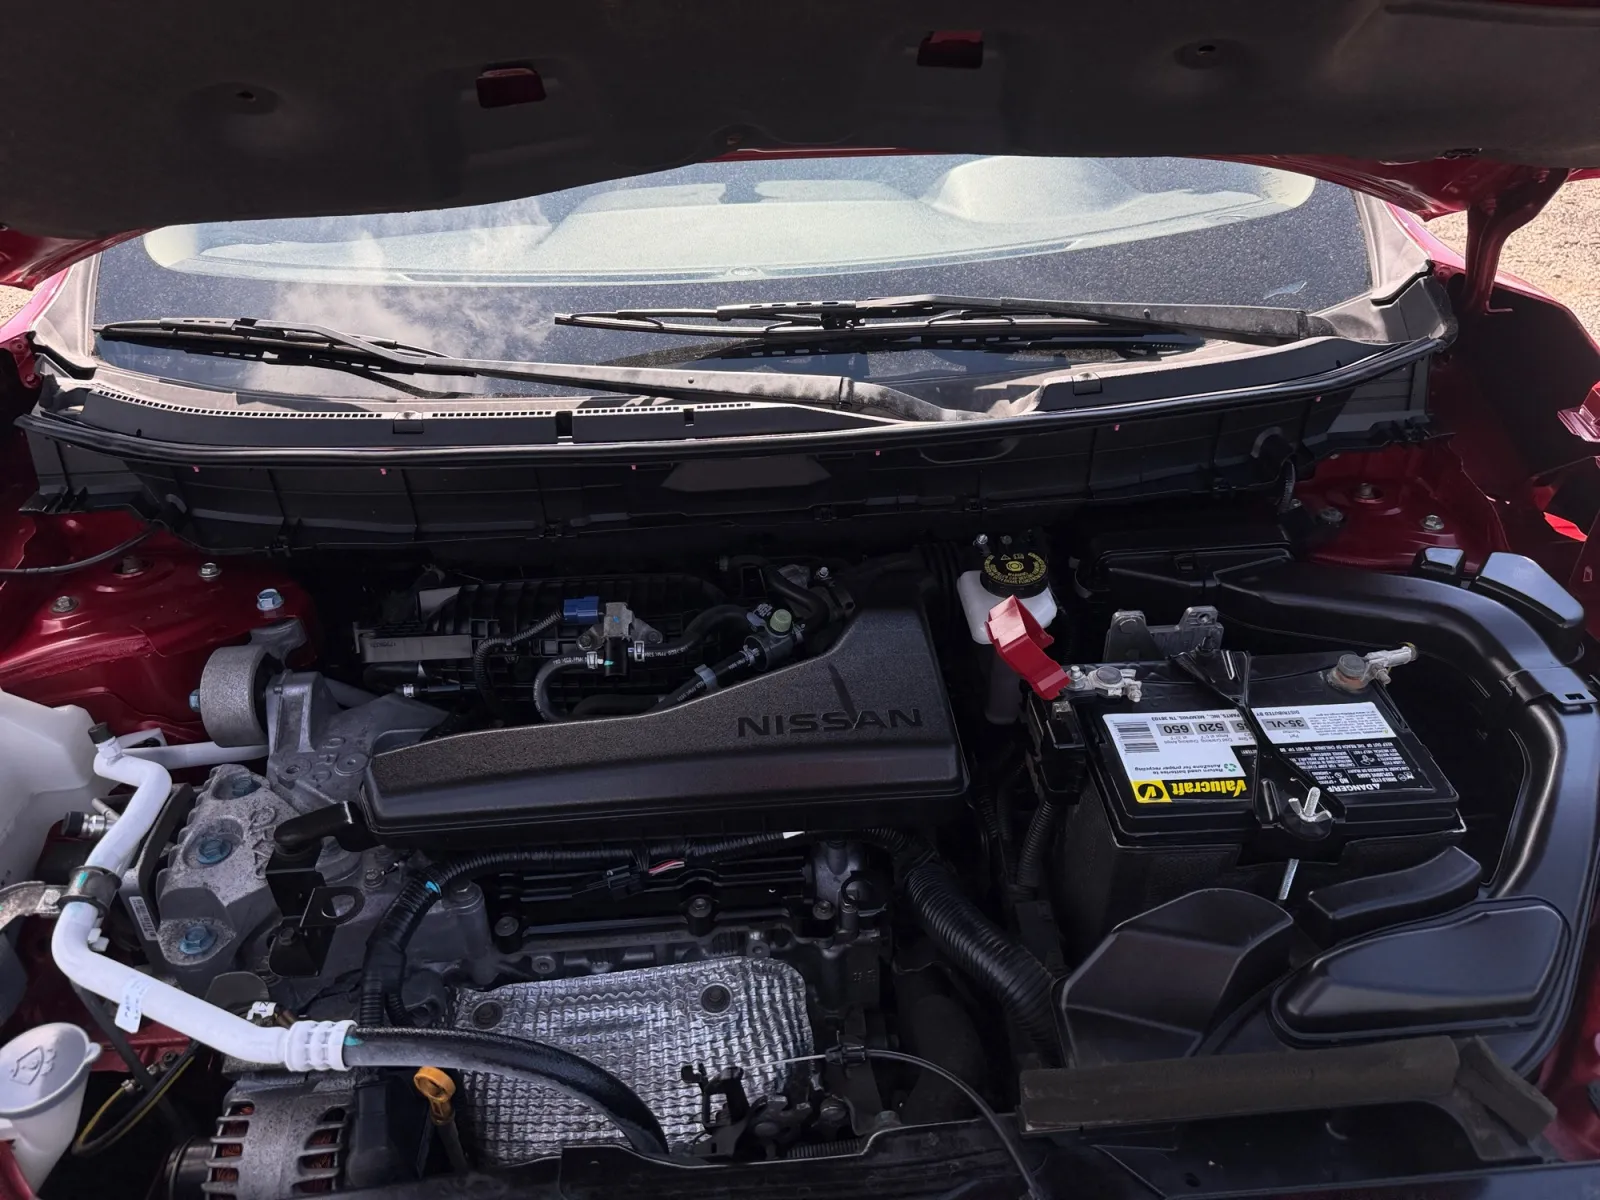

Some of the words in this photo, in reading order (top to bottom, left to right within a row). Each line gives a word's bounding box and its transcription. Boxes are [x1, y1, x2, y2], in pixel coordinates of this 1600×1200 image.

[737, 708, 923, 737] NISSAN
[1164, 724, 1189, 734] 650
[1198, 722, 1224, 732] 520
[1172, 779, 1247, 797] Valucraft
